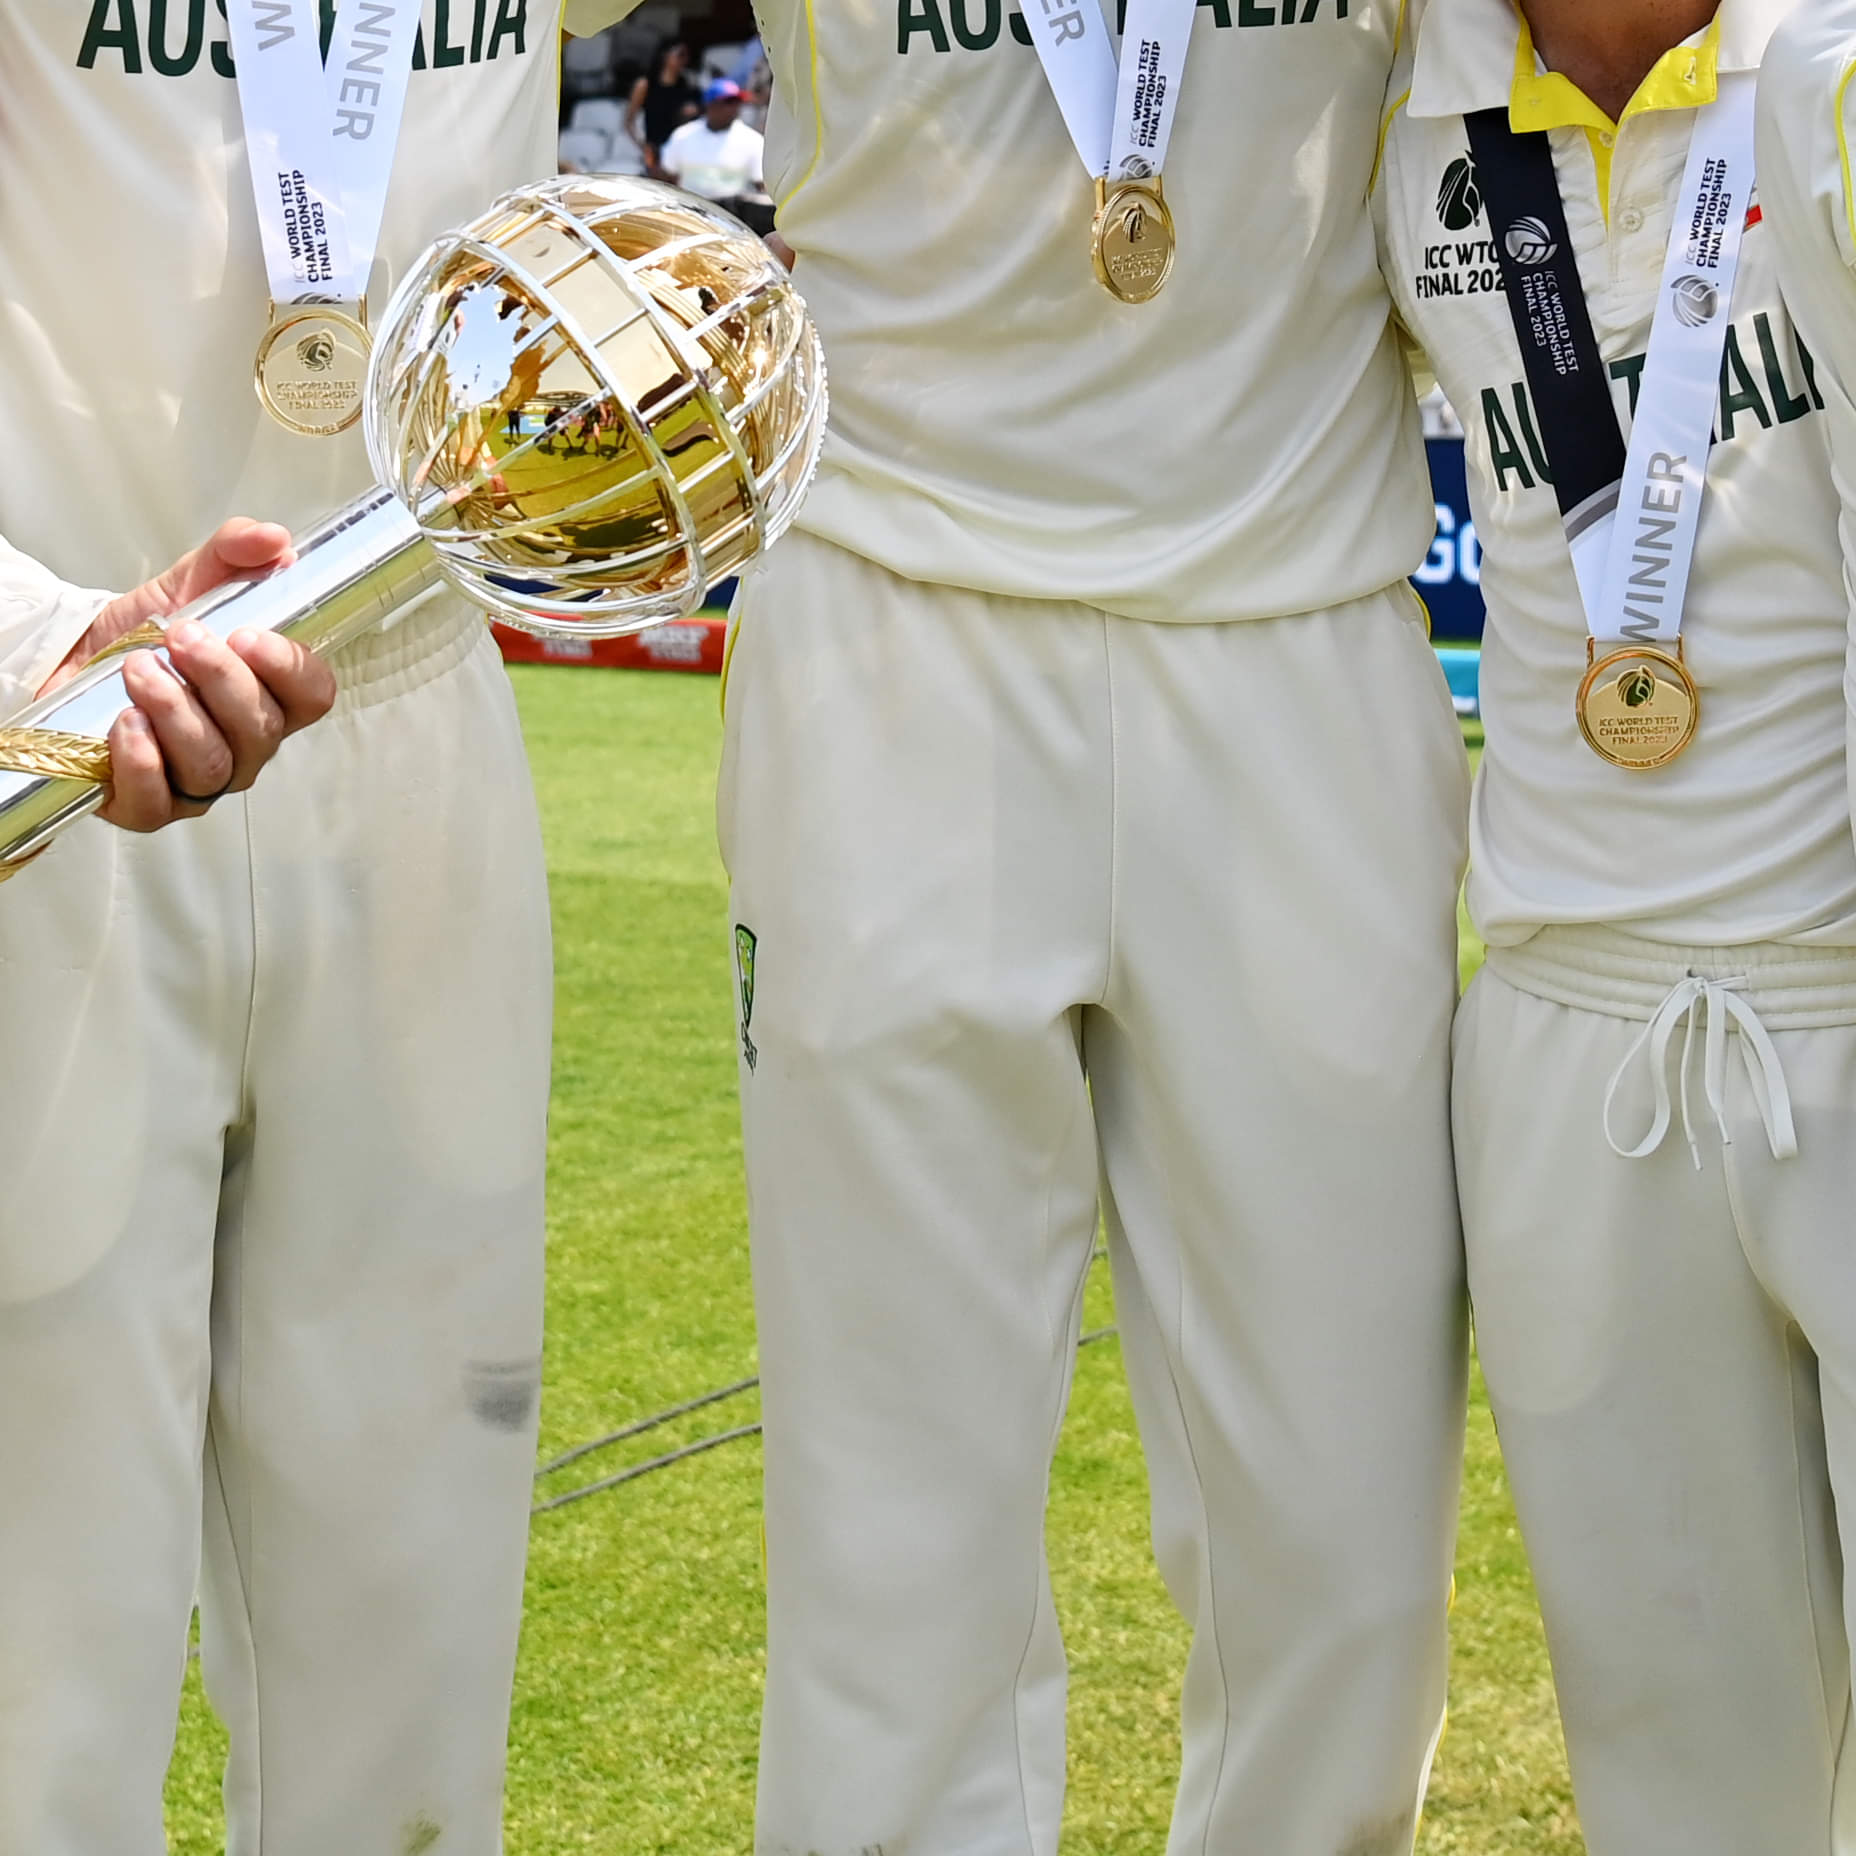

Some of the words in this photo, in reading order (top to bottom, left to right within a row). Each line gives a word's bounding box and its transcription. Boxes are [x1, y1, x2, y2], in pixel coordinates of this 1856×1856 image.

[1138, 39, 1151, 71] TEST
[1133, 73, 1146, 122] WORLD
[1139, 40, 1160, 147] CHAMPIONSHIP
[1154, 75, 1167, 107] 2023
[1147, 109, 1162, 148] FINAL
[278, 172, 293, 206] TEST
[1689, 193, 1708, 241] WORLD
[1700, 157, 1716, 190] TEST
[1696, 159, 1727, 267] CHAMPIONSHIP
[284, 208, 302, 259] WORLD
[292, 169, 319, 283] CHAMPIONSHIP
[311, 202, 326, 236] 2023
[1707, 229, 1724, 269] FINAL
[1716, 193, 1732, 225] 2023
[318, 239, 333, 281] FINAL
[1425, 245, 1452, 270] ICC
[1544, 270, 1559, 289] ICC
[1415, 272, 1464, 299] FINAL
[1467, 269, 1506, 294] 202
[1521, 275, 1537, 314] FINAL
[1530, 316, 1547, 347] 2023
[1533, 272, 1567, 375] CHAMPIONSHIP
[1550, 292, 1570, 340] WORLD
[1562, 341, 1579, 373] TEST
[1619, 452, 1688, 643] WINNER
